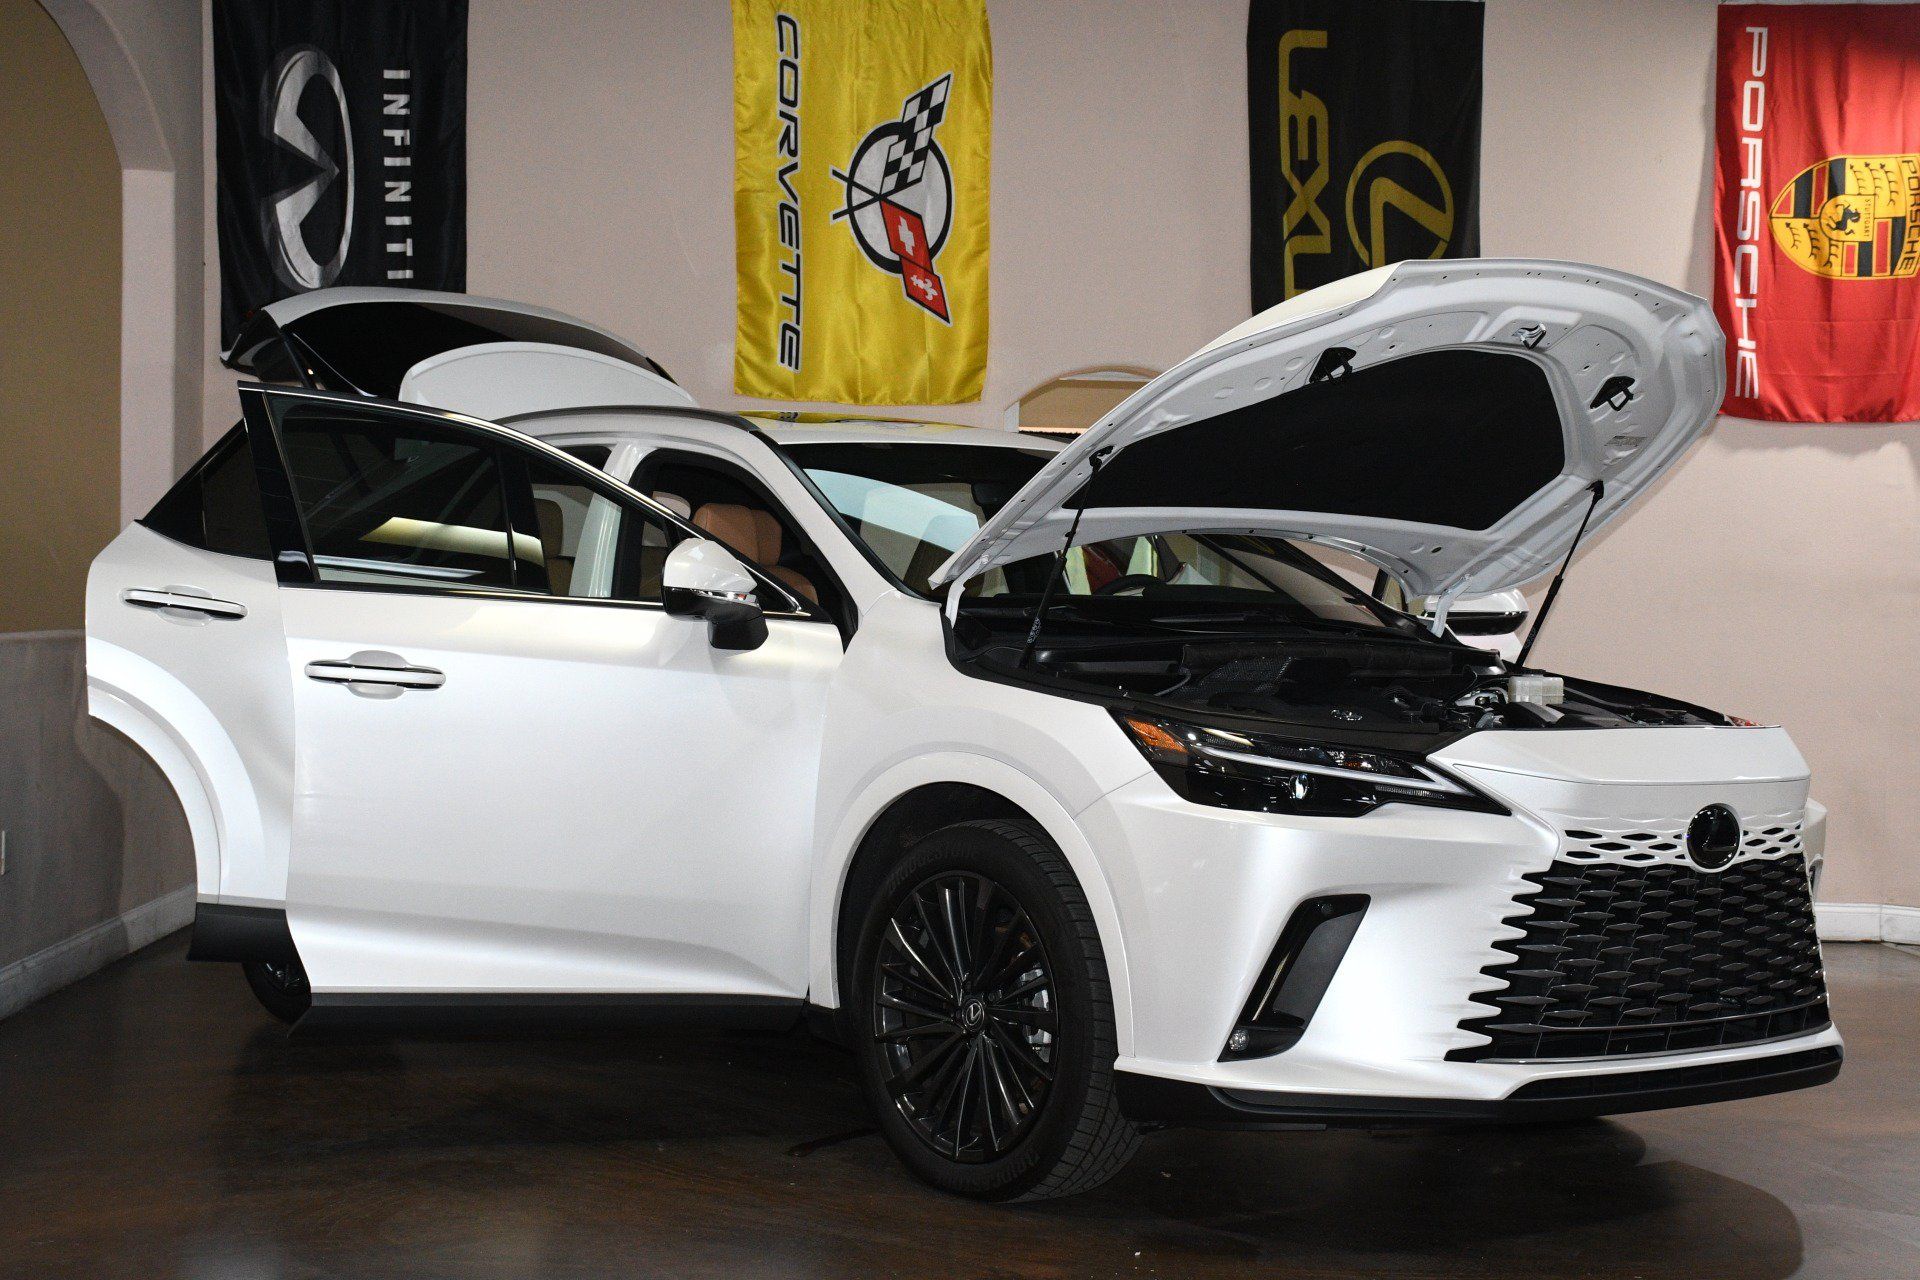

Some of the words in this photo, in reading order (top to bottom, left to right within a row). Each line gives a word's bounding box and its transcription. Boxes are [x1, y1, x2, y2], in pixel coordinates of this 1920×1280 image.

[383, 69, 414, 280] INFINITI
[776, 13, 801, 371] CORVETTE
[1278, 29, 1331, 300] LEXU
[1734, 26, 1769, 399] PORSCHE
[1900, 160, 1920, 271] PORSCHE
